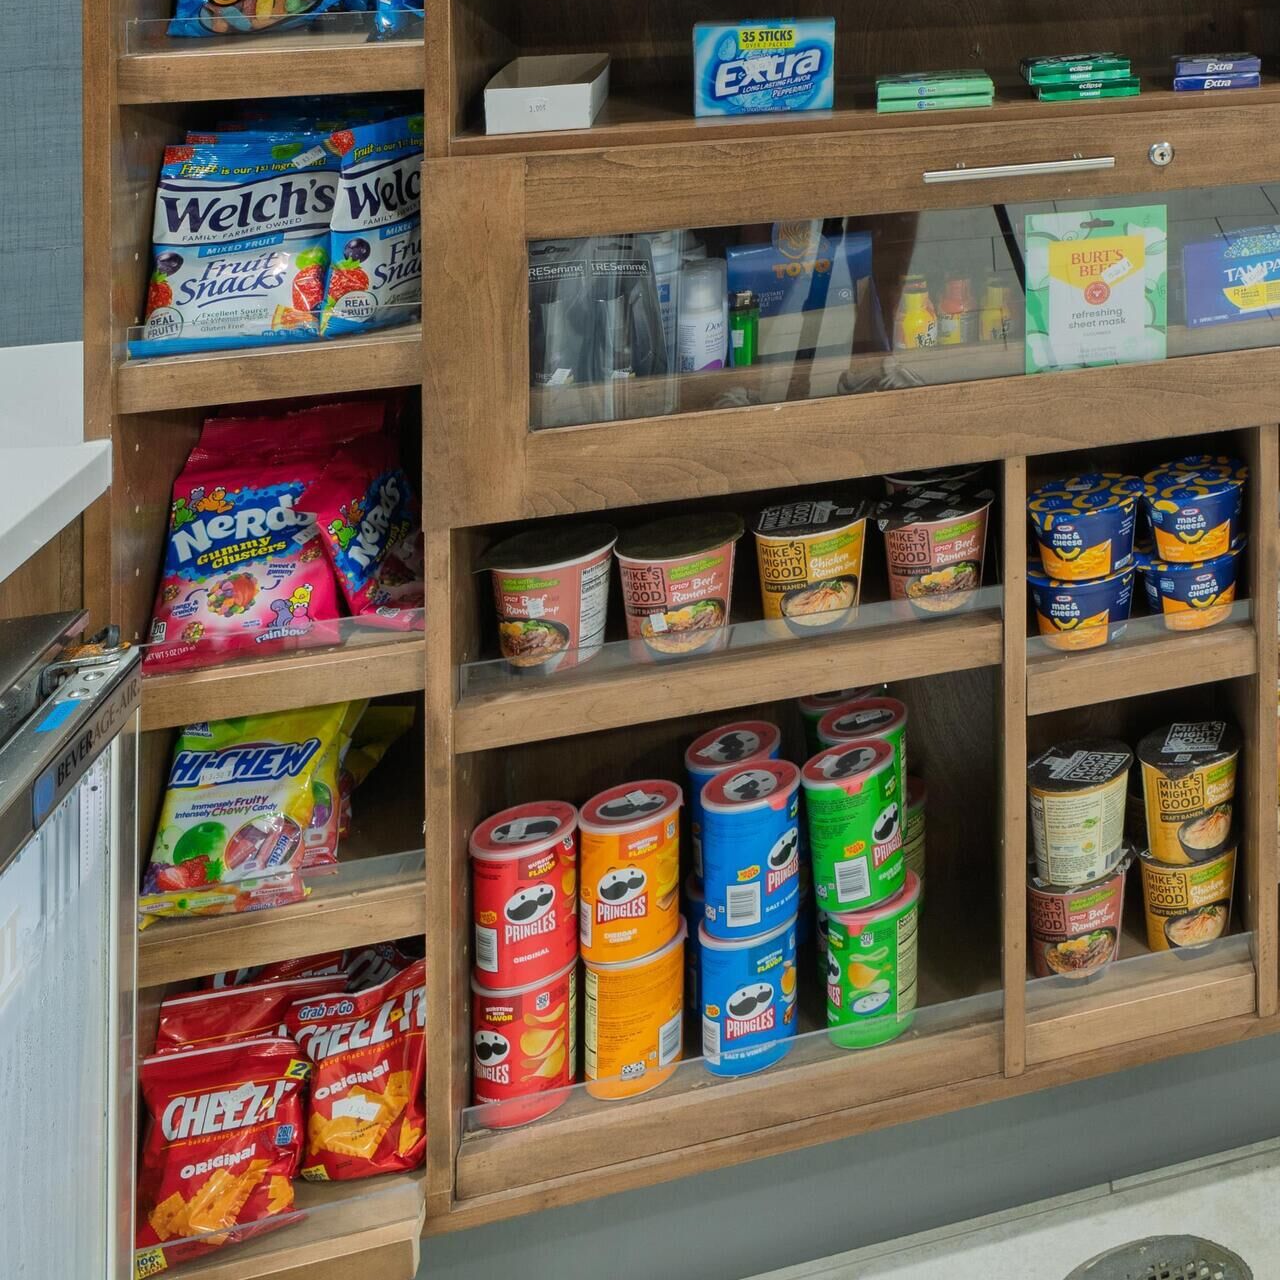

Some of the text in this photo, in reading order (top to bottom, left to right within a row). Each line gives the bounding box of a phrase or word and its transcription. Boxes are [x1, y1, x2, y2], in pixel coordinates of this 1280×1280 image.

[742, 30, 792, 42] 35 STICKS
[715, 49, 821, 97] Extra
[1206, 63, 1234, 72] Extra
[743, 75, 811, 93] LONG LASTING FLAVOR
[772, 83, 814, 98] PEPPERMINT
[1079, 81, 1103, 89] eclipse
[1204, 79, 1231, 88] Extra
[160, 179, 335, 234] Welch's
[182, 218, 302, 242] FAMILY FARMER OWNED
[206, 237, 276, 255] MIXED FRUIT
[1071, 250, 1124, 266] BURT'S
[200, 253, 280, 281] Fruit
[176, 270, 286, 306] Snacks
[344, 299, 370, 308] REAL
[1068, 315, 1126, 329] sheet mask
[1072, 307, 1123, 322] refreshing
[196, 536, 272, 566] Gummy
[955, 536, 975, 551] Beef
[212, 541, 287, 569] Clusters
[761, 546, 802, 558] MIKE'S
[892, 551, 927, 562] GOOD
[763, 557, 802, 567] MIGHTY
[810, 553, 849, 568] Chicken
[765, 566, 803, 579] GOOD
[692, 573, 716, 589] Beef
[255, 628, 308, 644] rainbow
[169, 739, 321, 787] HI-CHEW
[1160, 777, 1201, 789] MIKE'S
[1161, 788, 1200, 798] MIGHTY
[191, 794, 268, 811] Immensely Fruity
[1162, 796, 1201, 809] GOOD
[174, 803, 277, 819] Intensely Chewy Candy
[628, 844, 659, 857] FLAVOR
[529, 862, 555, 878] FLAVOR
[597, 896, 647, 921] PRINGLES
[505, 910, 556, 944] PRINGLES
[513, 949, 550, 964] ORIGINAL
[300, 1001, 353, 1020] Grab Go
[486, 1014, 512, 1022] FLAVOR
[726, 1015, 775, 1038] PRINGLES
